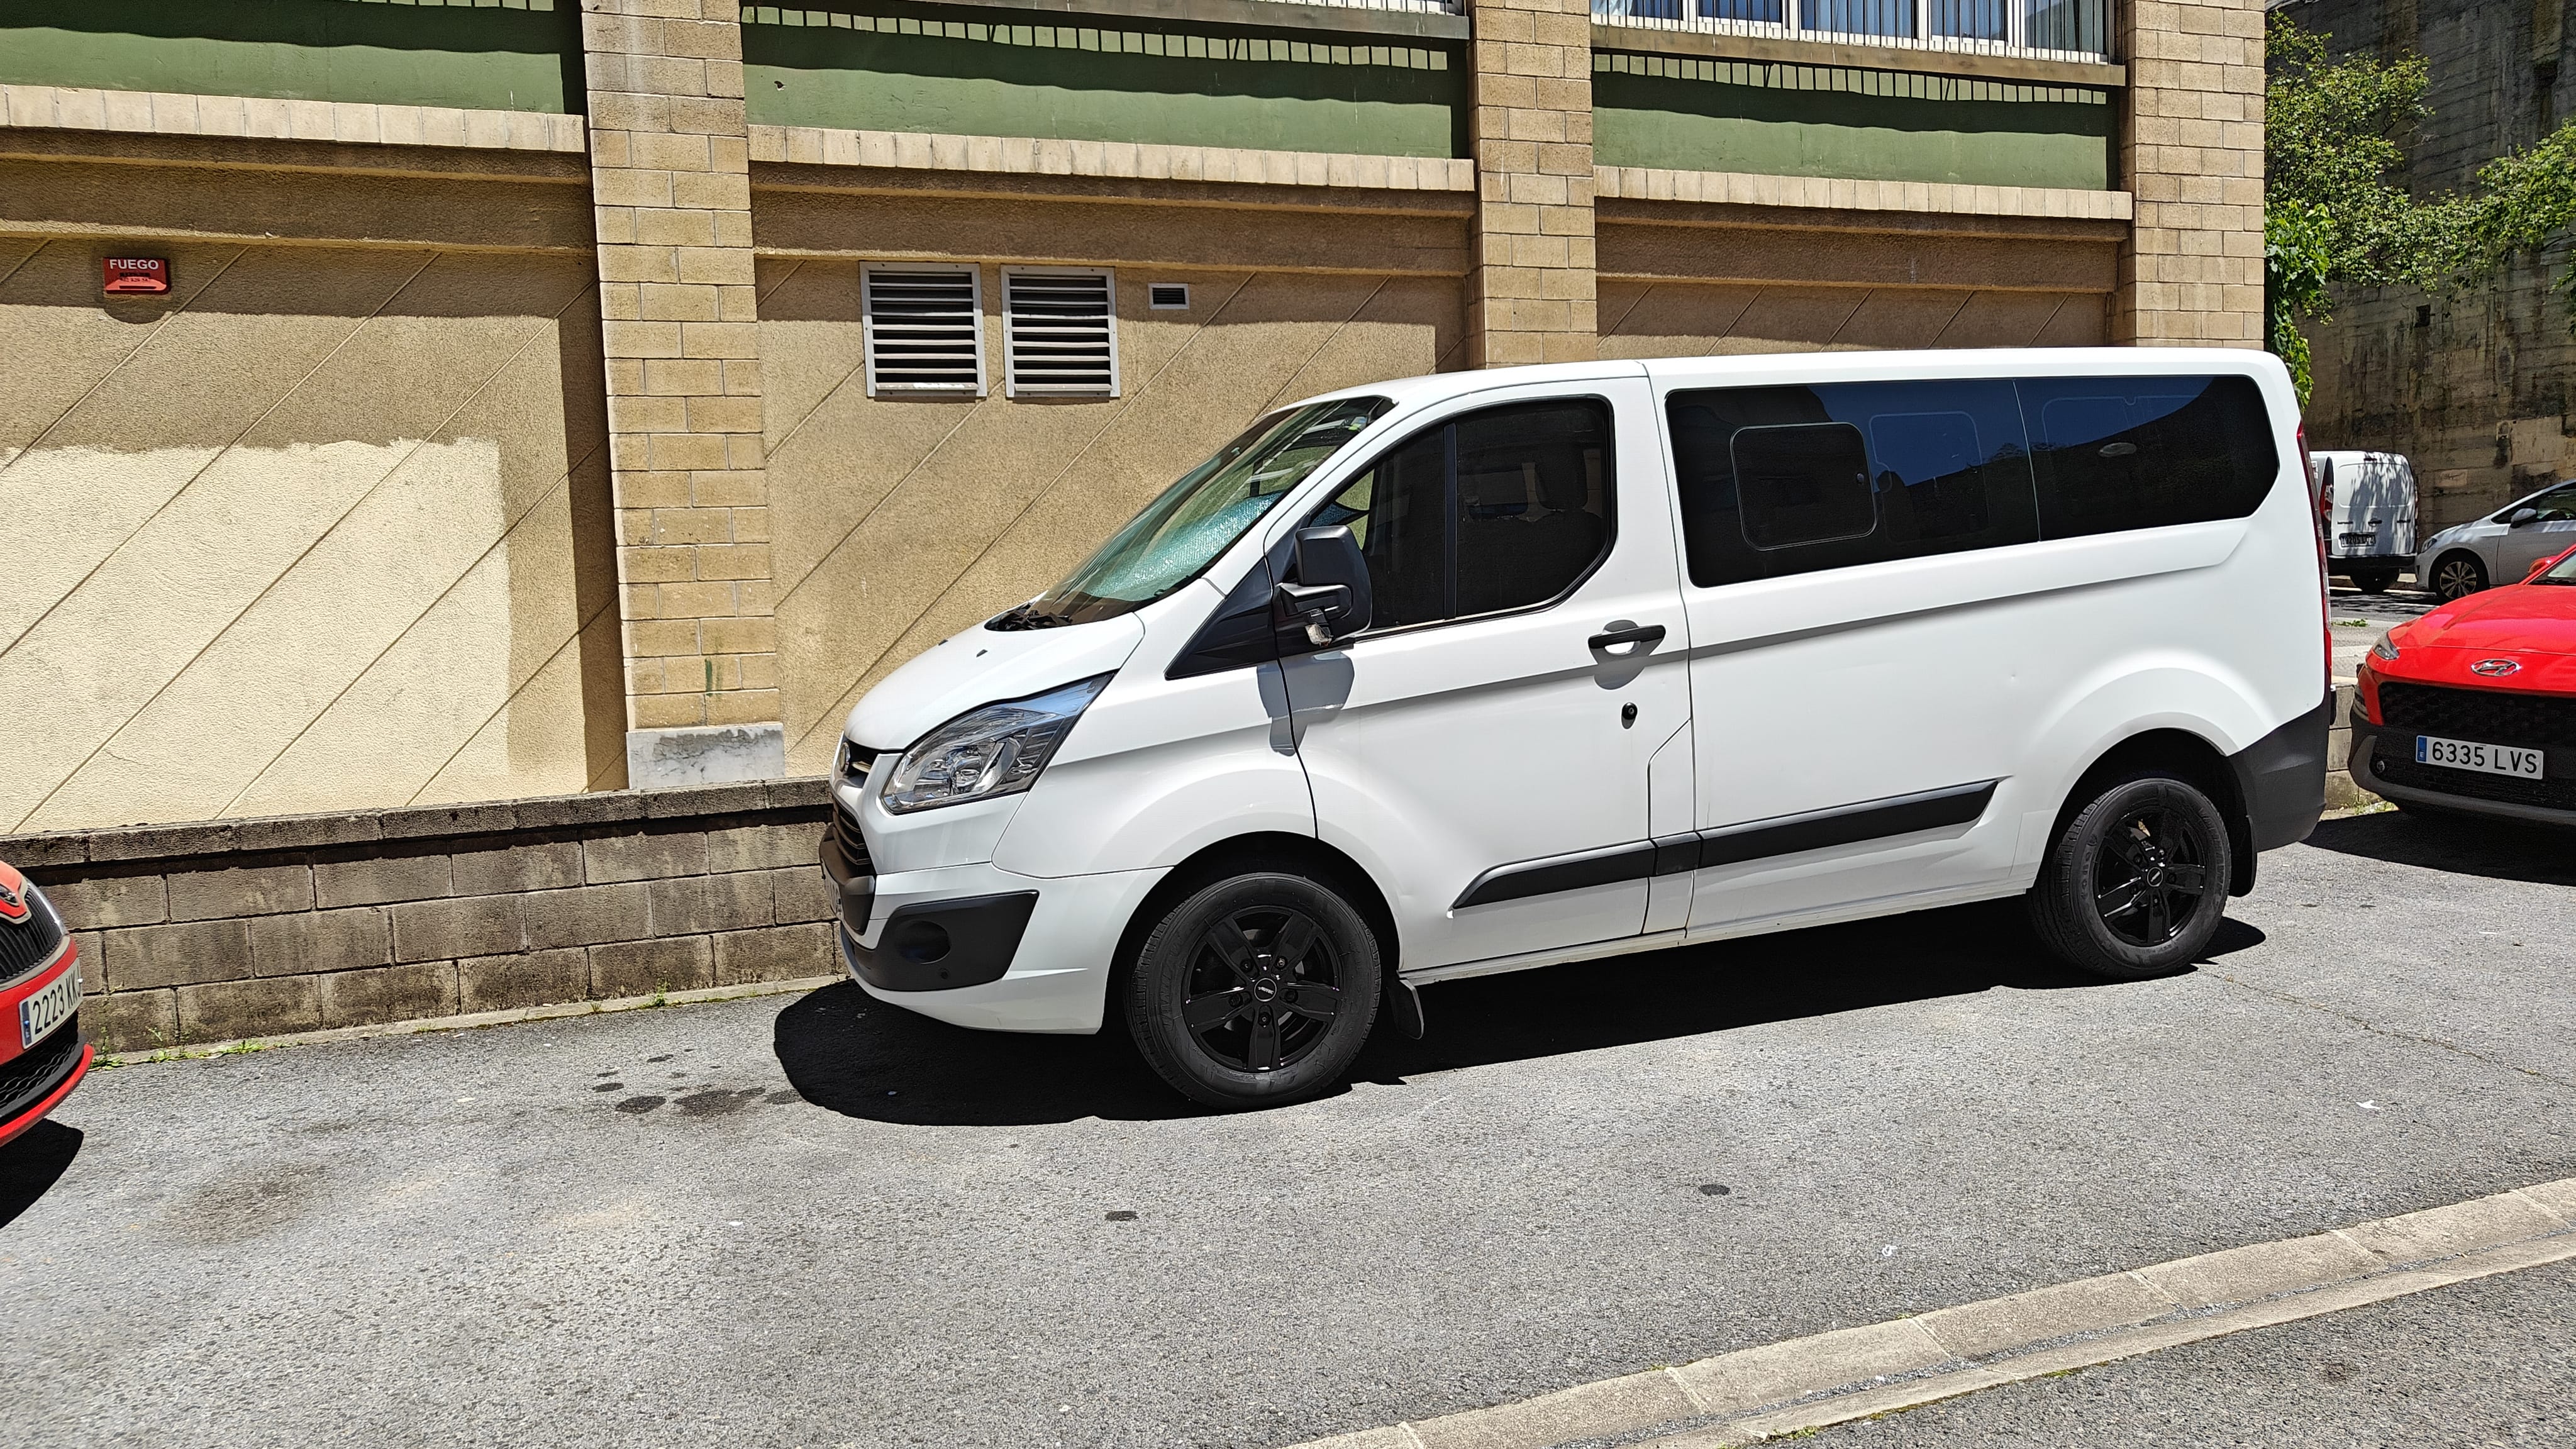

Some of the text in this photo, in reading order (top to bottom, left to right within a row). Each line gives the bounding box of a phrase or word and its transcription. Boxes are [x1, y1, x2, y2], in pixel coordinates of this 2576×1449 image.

[109, 259, 158, 269] FUEGO
[2432, 741, 2537, 774] 6335 LVS
[33, 965, 81, 1035] 2223 KKJ
